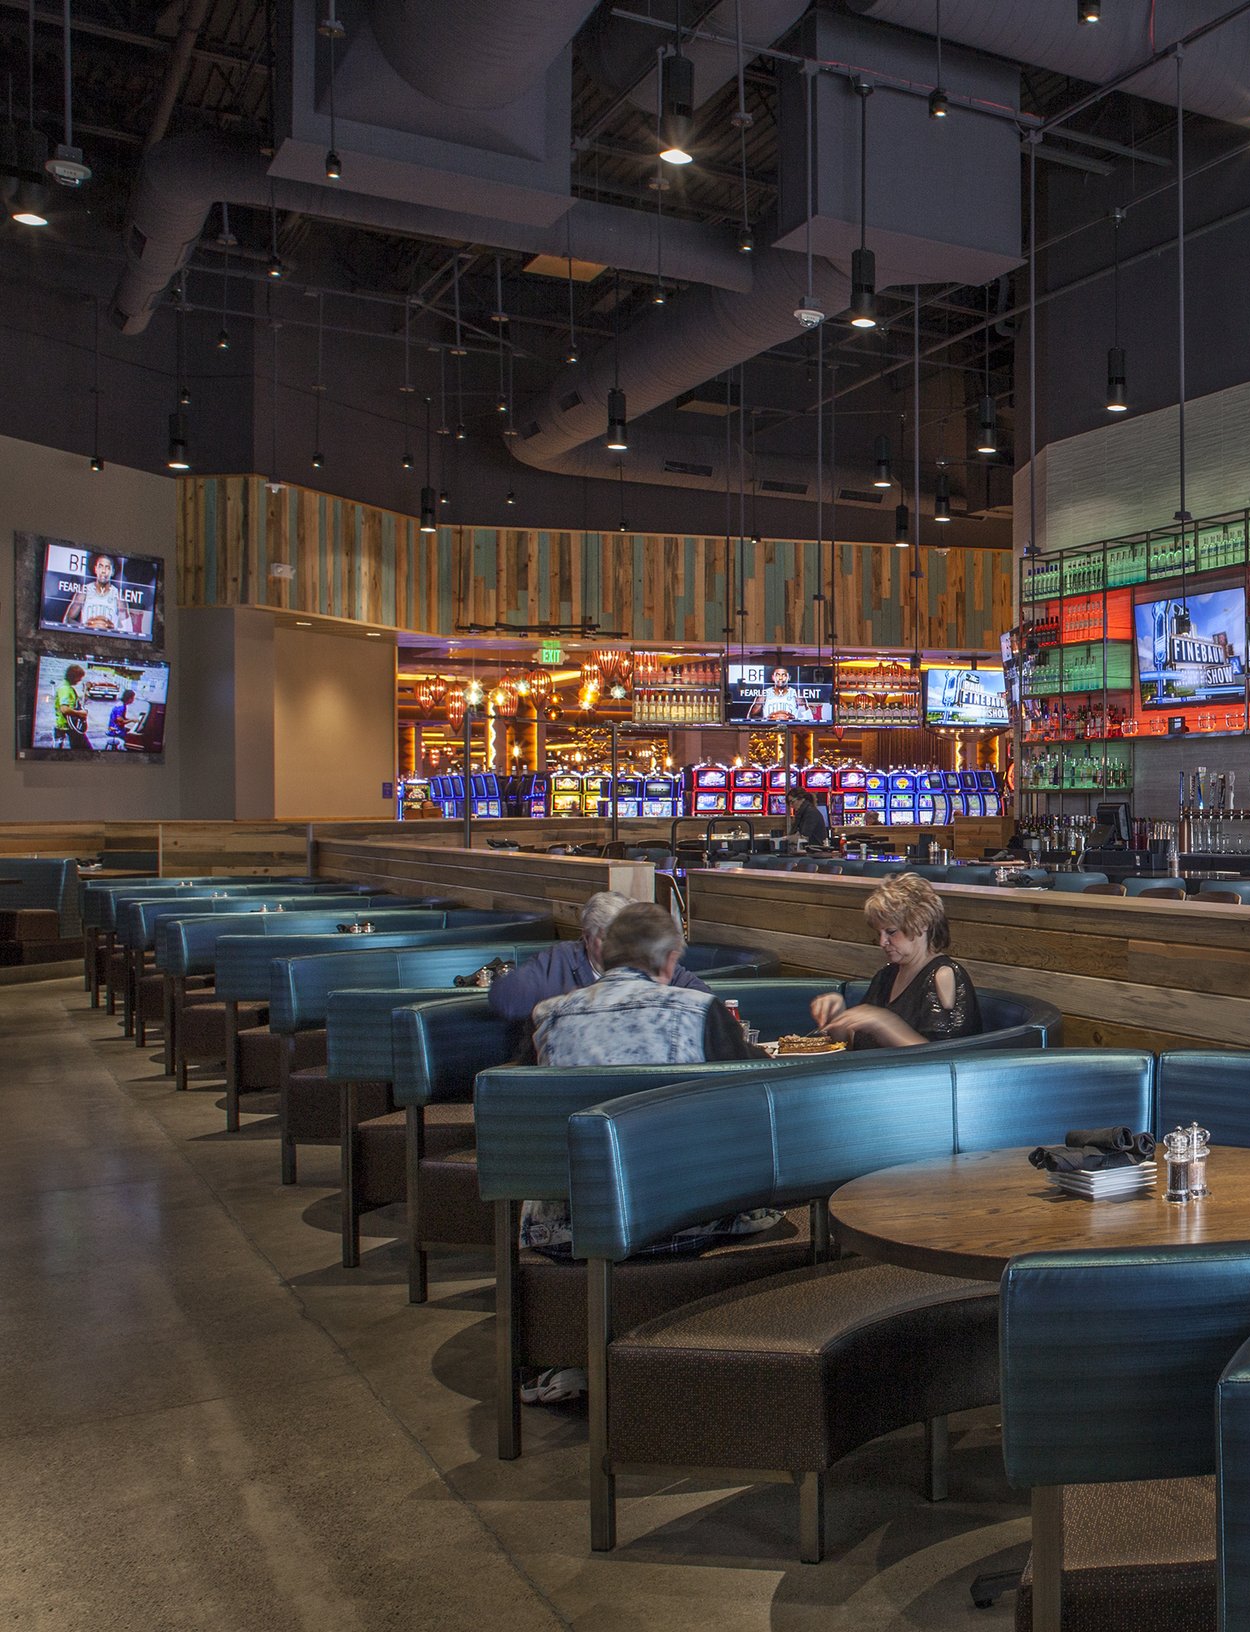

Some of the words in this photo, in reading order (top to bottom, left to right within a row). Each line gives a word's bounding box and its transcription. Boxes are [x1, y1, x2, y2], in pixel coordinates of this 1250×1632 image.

[543, 649, 561, 663] EXIT
[1206, 666, 1233, 685] SHOW
[988, 709, 1008, 718] SHOW
